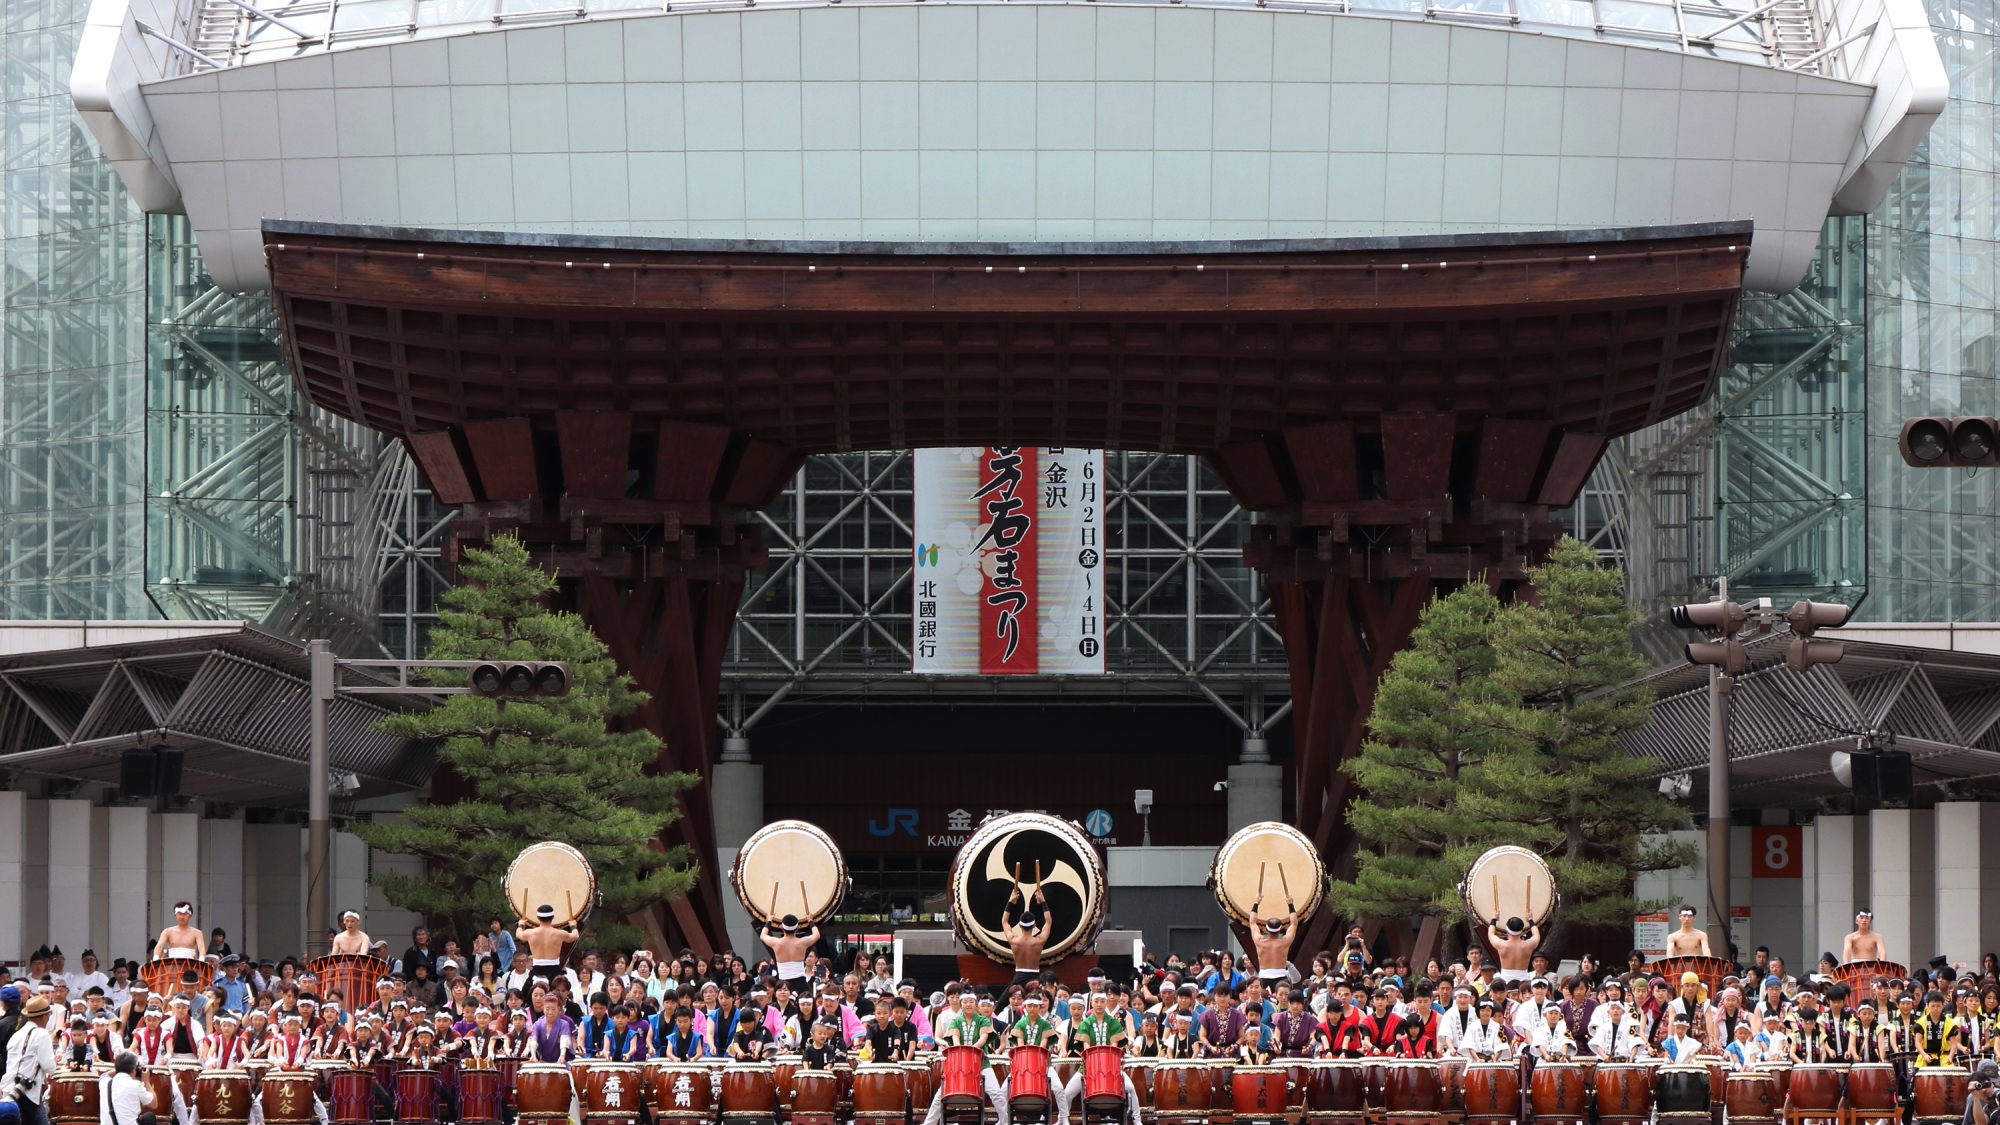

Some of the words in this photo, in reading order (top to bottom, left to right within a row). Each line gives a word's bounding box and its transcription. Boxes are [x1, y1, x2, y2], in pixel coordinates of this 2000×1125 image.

[919, 581, 937, 658] 北國銀行
[869, 808, 920, 836] JR
[927, 835, 970, 847] KANA
[1765, 834, 1789, 870] 8
[215, 1083, 232, 1115] 九谷
[278, 1083, 295, 1115] 九谷
